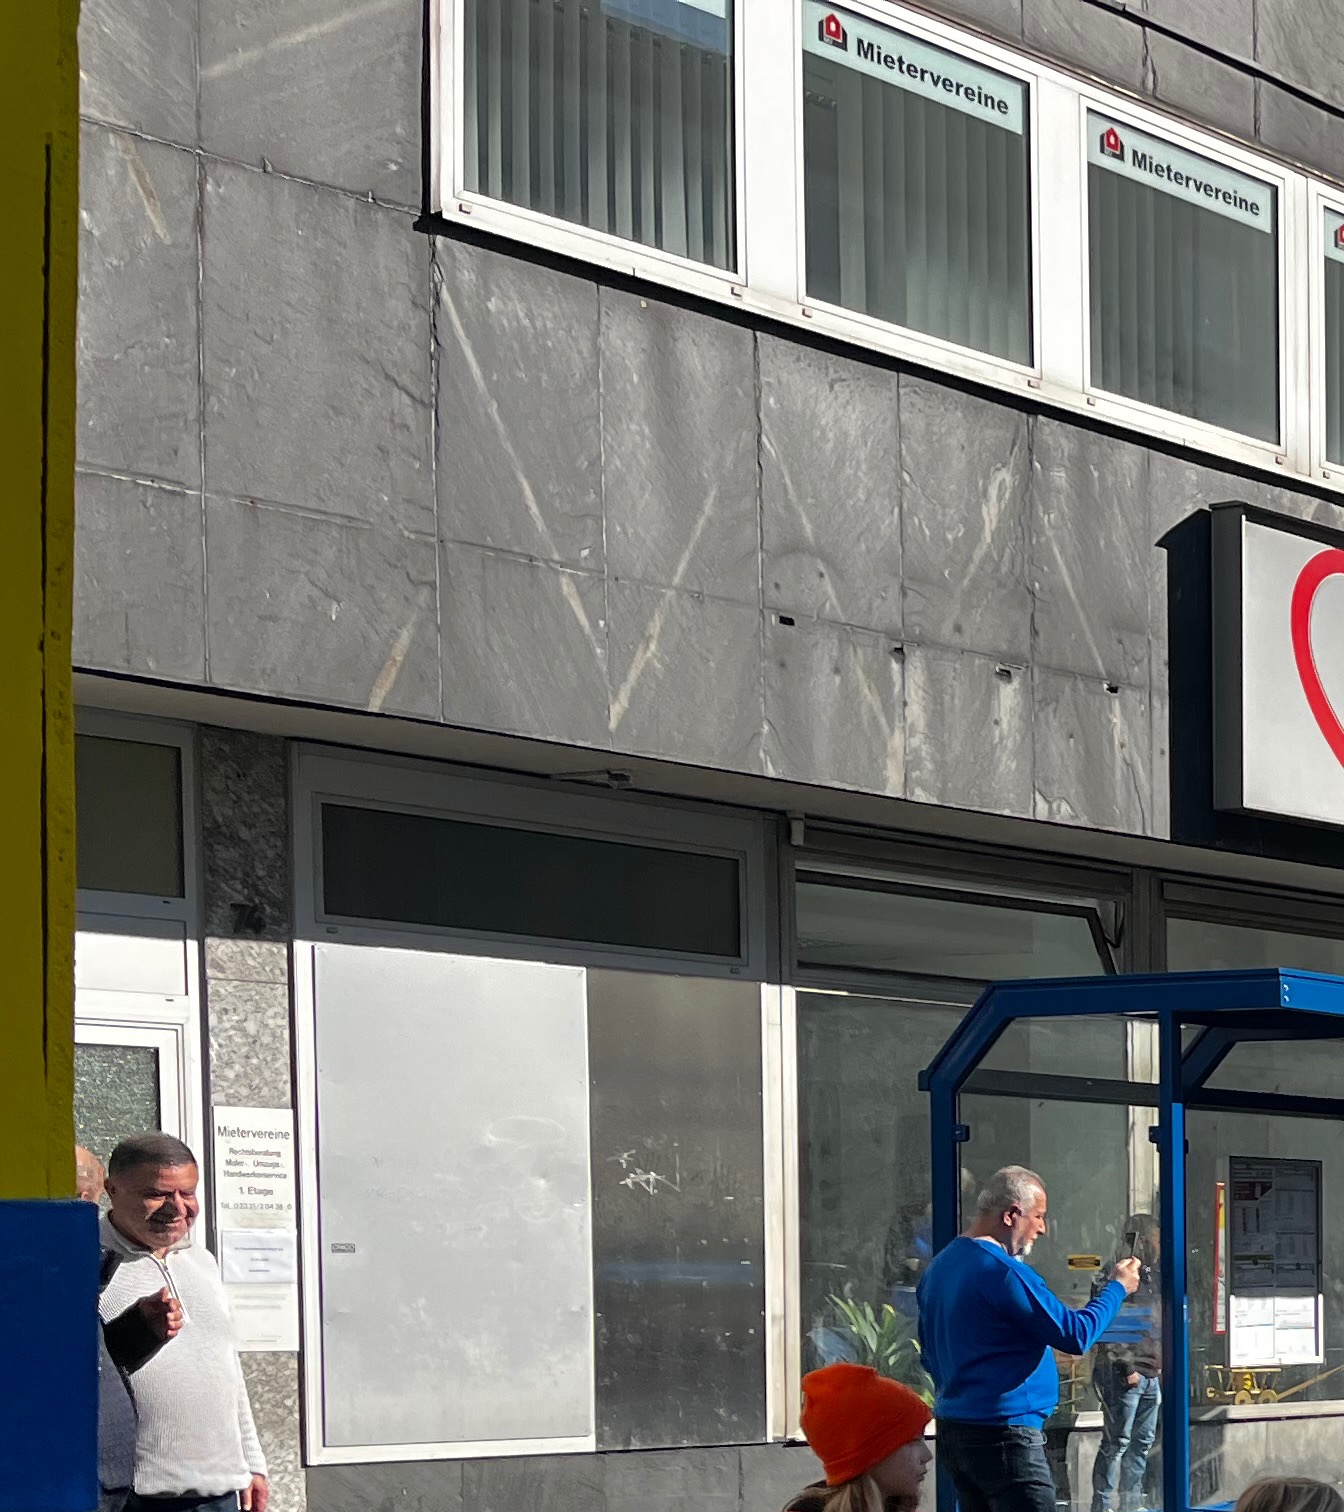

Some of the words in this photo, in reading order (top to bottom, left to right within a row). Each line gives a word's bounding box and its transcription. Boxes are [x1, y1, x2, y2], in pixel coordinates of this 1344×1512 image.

[856, 37, 1010, 116] Mietervereine
[1130, 147, 1261, 217] Mietervereine
[217, 1125, 291, 1140] Mietervereine
